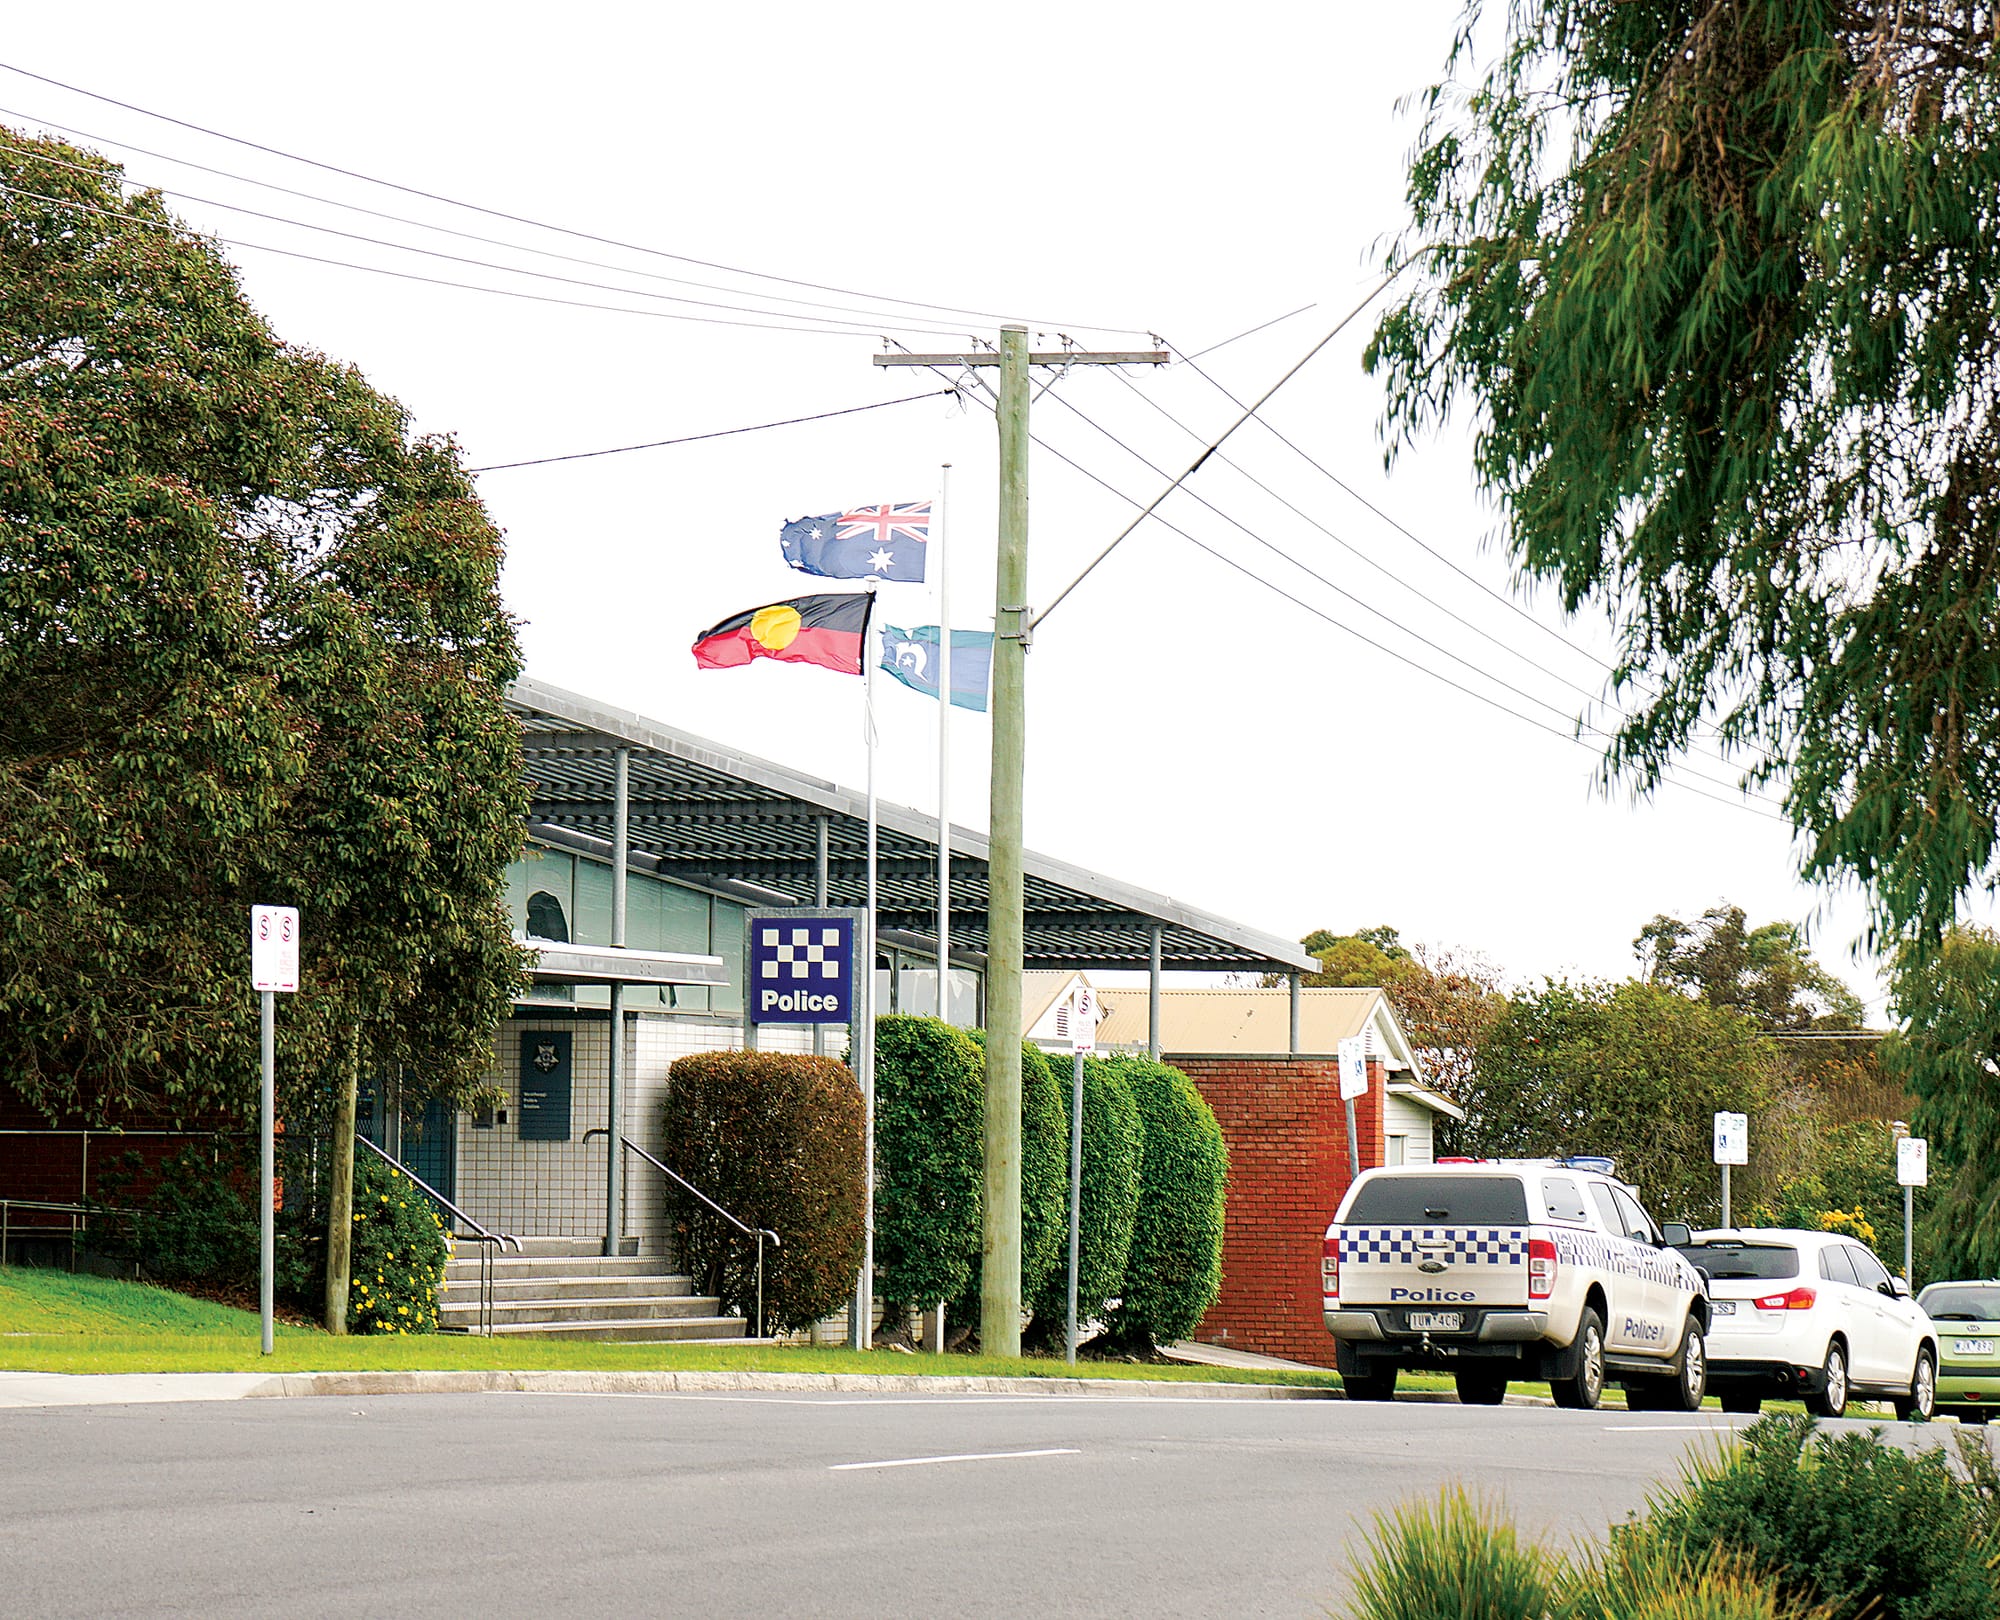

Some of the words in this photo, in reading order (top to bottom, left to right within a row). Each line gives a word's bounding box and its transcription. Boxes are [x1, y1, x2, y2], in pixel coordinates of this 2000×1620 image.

[761, 989, 839, 1012] Police
[1390, 1287, 1476, 1302] Police
[1623, 1316, 1659, 1341] Police
